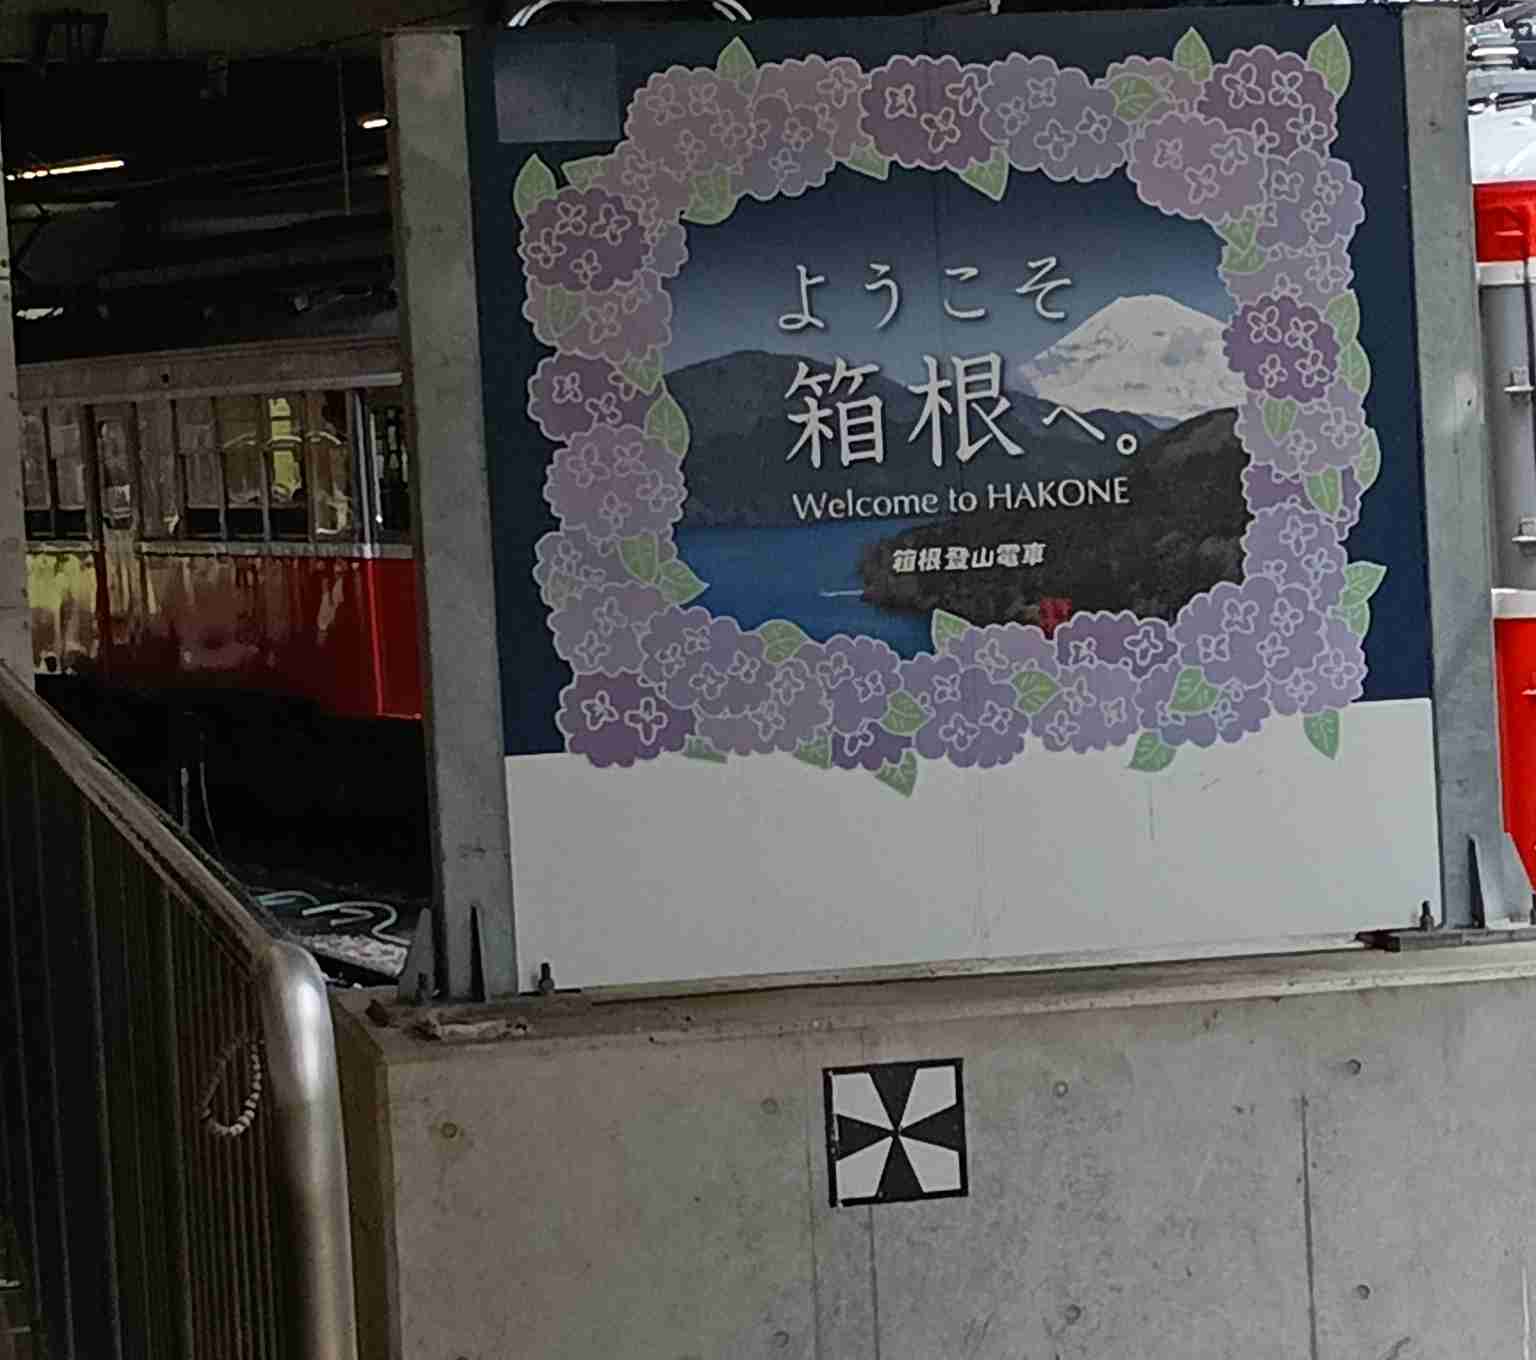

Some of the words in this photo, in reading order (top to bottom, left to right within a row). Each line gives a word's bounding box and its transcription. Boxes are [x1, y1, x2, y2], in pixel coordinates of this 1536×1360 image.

[779, 257, 1072, 329] ようこそ
[785, 352, 1139, 468] 箱根へ。
[792, 488, 940, 520] Welcome
[949, 487, 978, 512] to
[987, 476, 1131, 510] HAKONE
[893, 542, 1047, 573] 箱根登山電車
